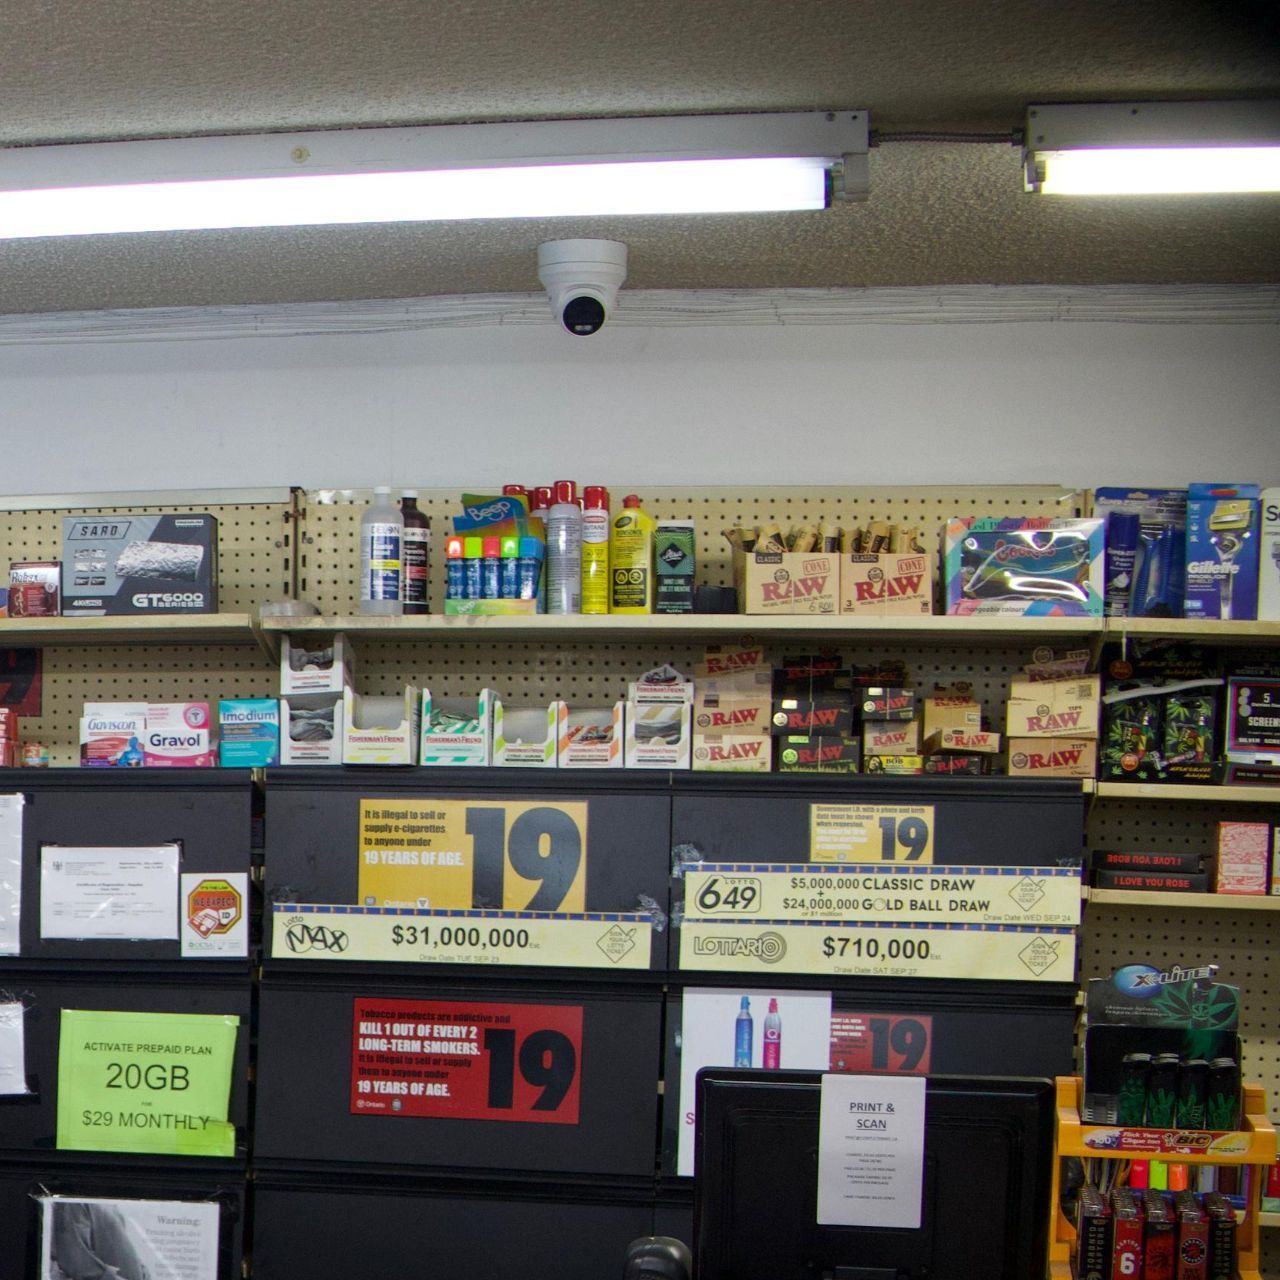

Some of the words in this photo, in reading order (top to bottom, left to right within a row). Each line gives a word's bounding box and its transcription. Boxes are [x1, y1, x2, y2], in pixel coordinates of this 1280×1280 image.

[1187, 561, 1240, 575] Gillette
[221, 710, 276, 722] Imodium
[711, 707, 759, 727] RAW
[87, 720, 137, 732] Gaviscon
[365, 810, 371, 819] It
[372, 810, 380, 819] is
[381, 811, 408, 821] illegal
[410, 811, 417, 819] to
[420, 811, 436, 820] sell
[437, 812, 446, 820] or
[364, 824, 393, 834] supply
[394, 824, 446, 834] e-cigarettes
[364, 837, 373, 846] to
[374, 838, 404, 847] anyone
[406, 838, 431, 846] under
[879, 817, 930, 861] 19
[365, 851, 379, 865] 19
[381, 851, 418, 865] YEARS
[421, 852, 436, 865] OF
[438, 852, 464, 866] AGE.
[465, 807, 582, 911] 19
[791, 877, 860, 890] $5,000,000
[862, 878, 924, 892] CLASSIC
[930, 879, 975, 892] DRAW
[783, 898, 860, 912] $24,000,000
[909, 899, 943, 912] BALL
[949, 900, 991, 913] DRAW
[392, 925, 529, 949] $31,000,000
[823, 937, 930, 960] $710,000
[360, 1022, 382, 1035] KILL
[384, 1023, 390, 1035] 1
[392, 1023, 415, 1036] OUT
[417, 1024, 431, 1037] OF
[433, 1025, 467, 1038] EVERY
[469, 1026, 477, 1039] 2
[83, 1042, 133, 1053] ACTIVATE
[136, 1043, 181, 1055] PREPAID
[183, 1044, 212, 1055] PLAN
[359, 1038, 421, 1053] LONG-TERM
[423, 1041, 481, 1055] SMOKERS.
[869, 1019, 927, 1070] 19
[105, 1063, 190, 1091] 20GB
[484, 1028, 576, 1111] 19
[358, 1081, 371, 1093] 19
[373, 1081, 408, 1094] YEARS
[410, 1083, 424, 1094] OF
[426, 1083, 450, 1096] AGE.
[849, 1101, 882, 1113] PRINT
[885, 1103, 895, 1113] &
[82, 1111, 113, 1127] $29
[118, 1112, 210, 1131] MONTHLY
[856, 1118, 886, 1129] SCAN
